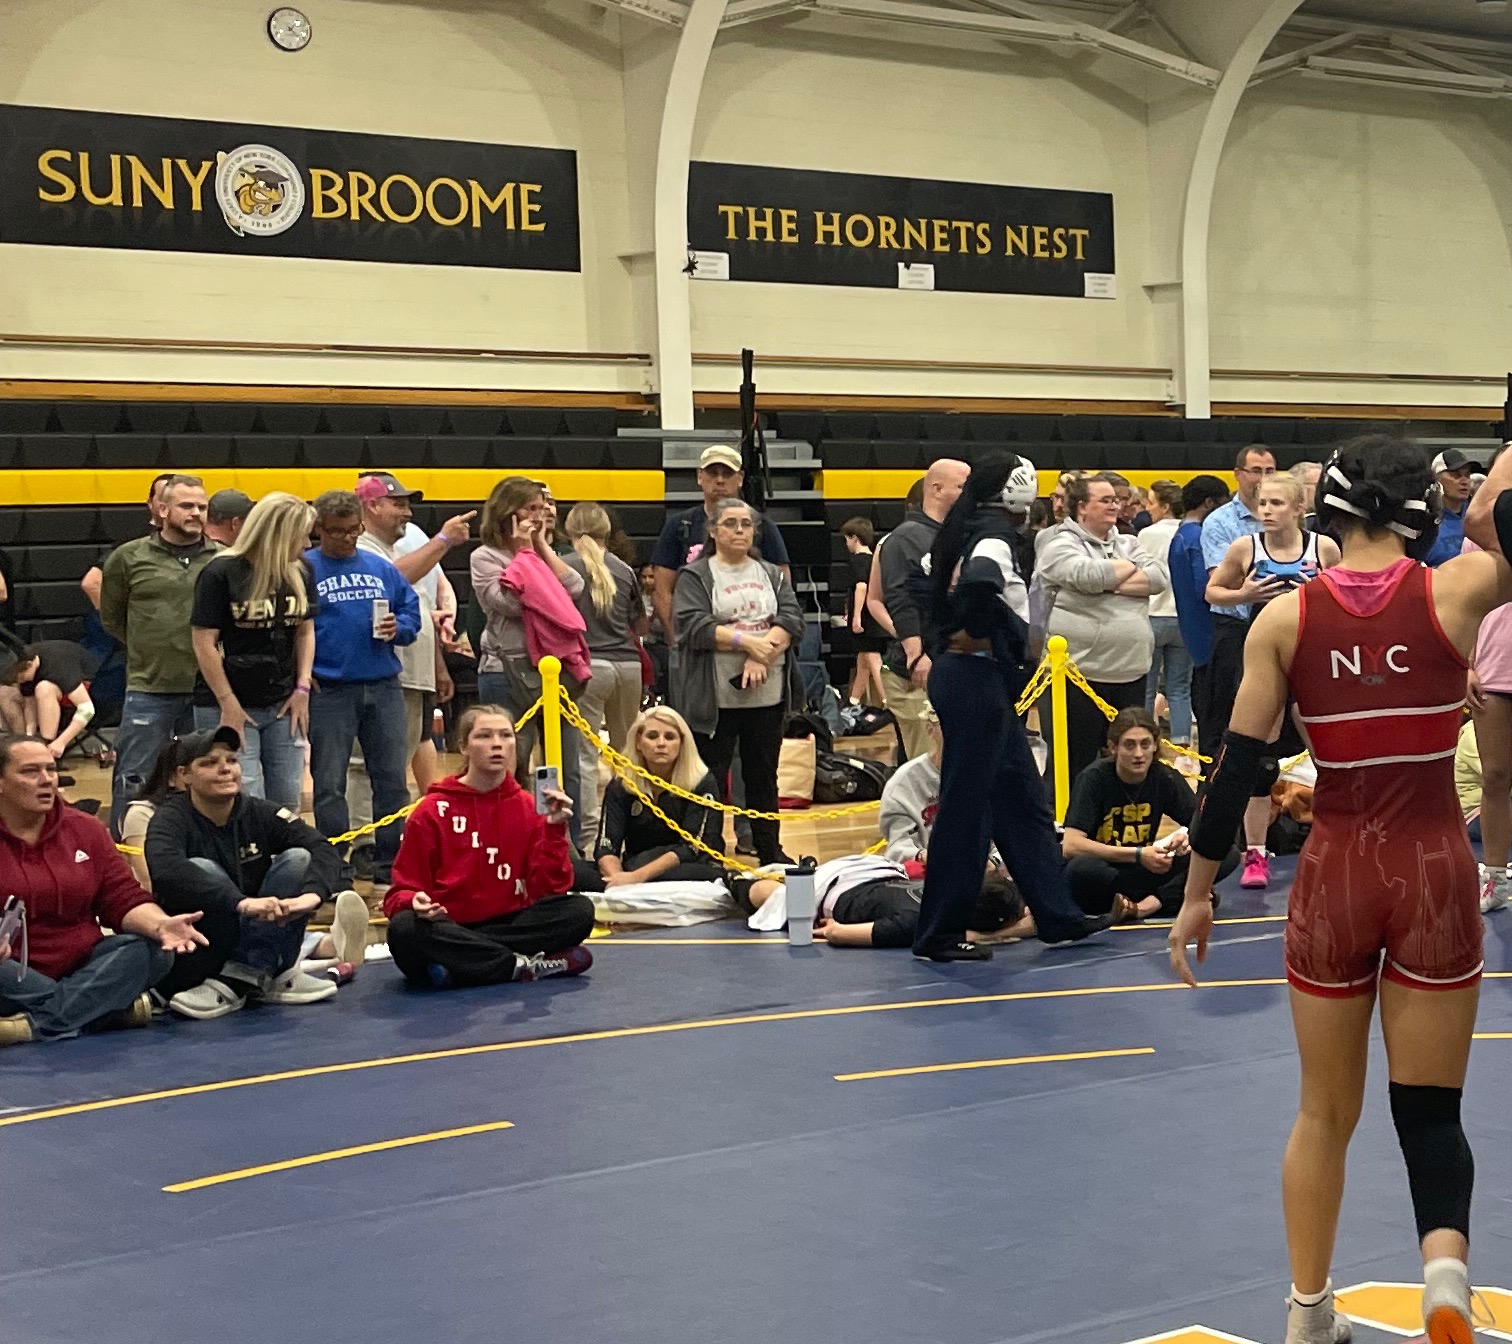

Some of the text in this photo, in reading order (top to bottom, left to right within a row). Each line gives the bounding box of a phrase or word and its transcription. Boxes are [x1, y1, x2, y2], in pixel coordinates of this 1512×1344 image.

[37, 149, 214, 211] SUNY
[309, 168, 547, 232] BROOME
[718, 205, 1090, 261] THE HORNETS NEST
[316, 573, 386, 597] SHAKER
[327, 588, 383, 603] SOCCER
[1330, 644, 1410, 679] NYC
